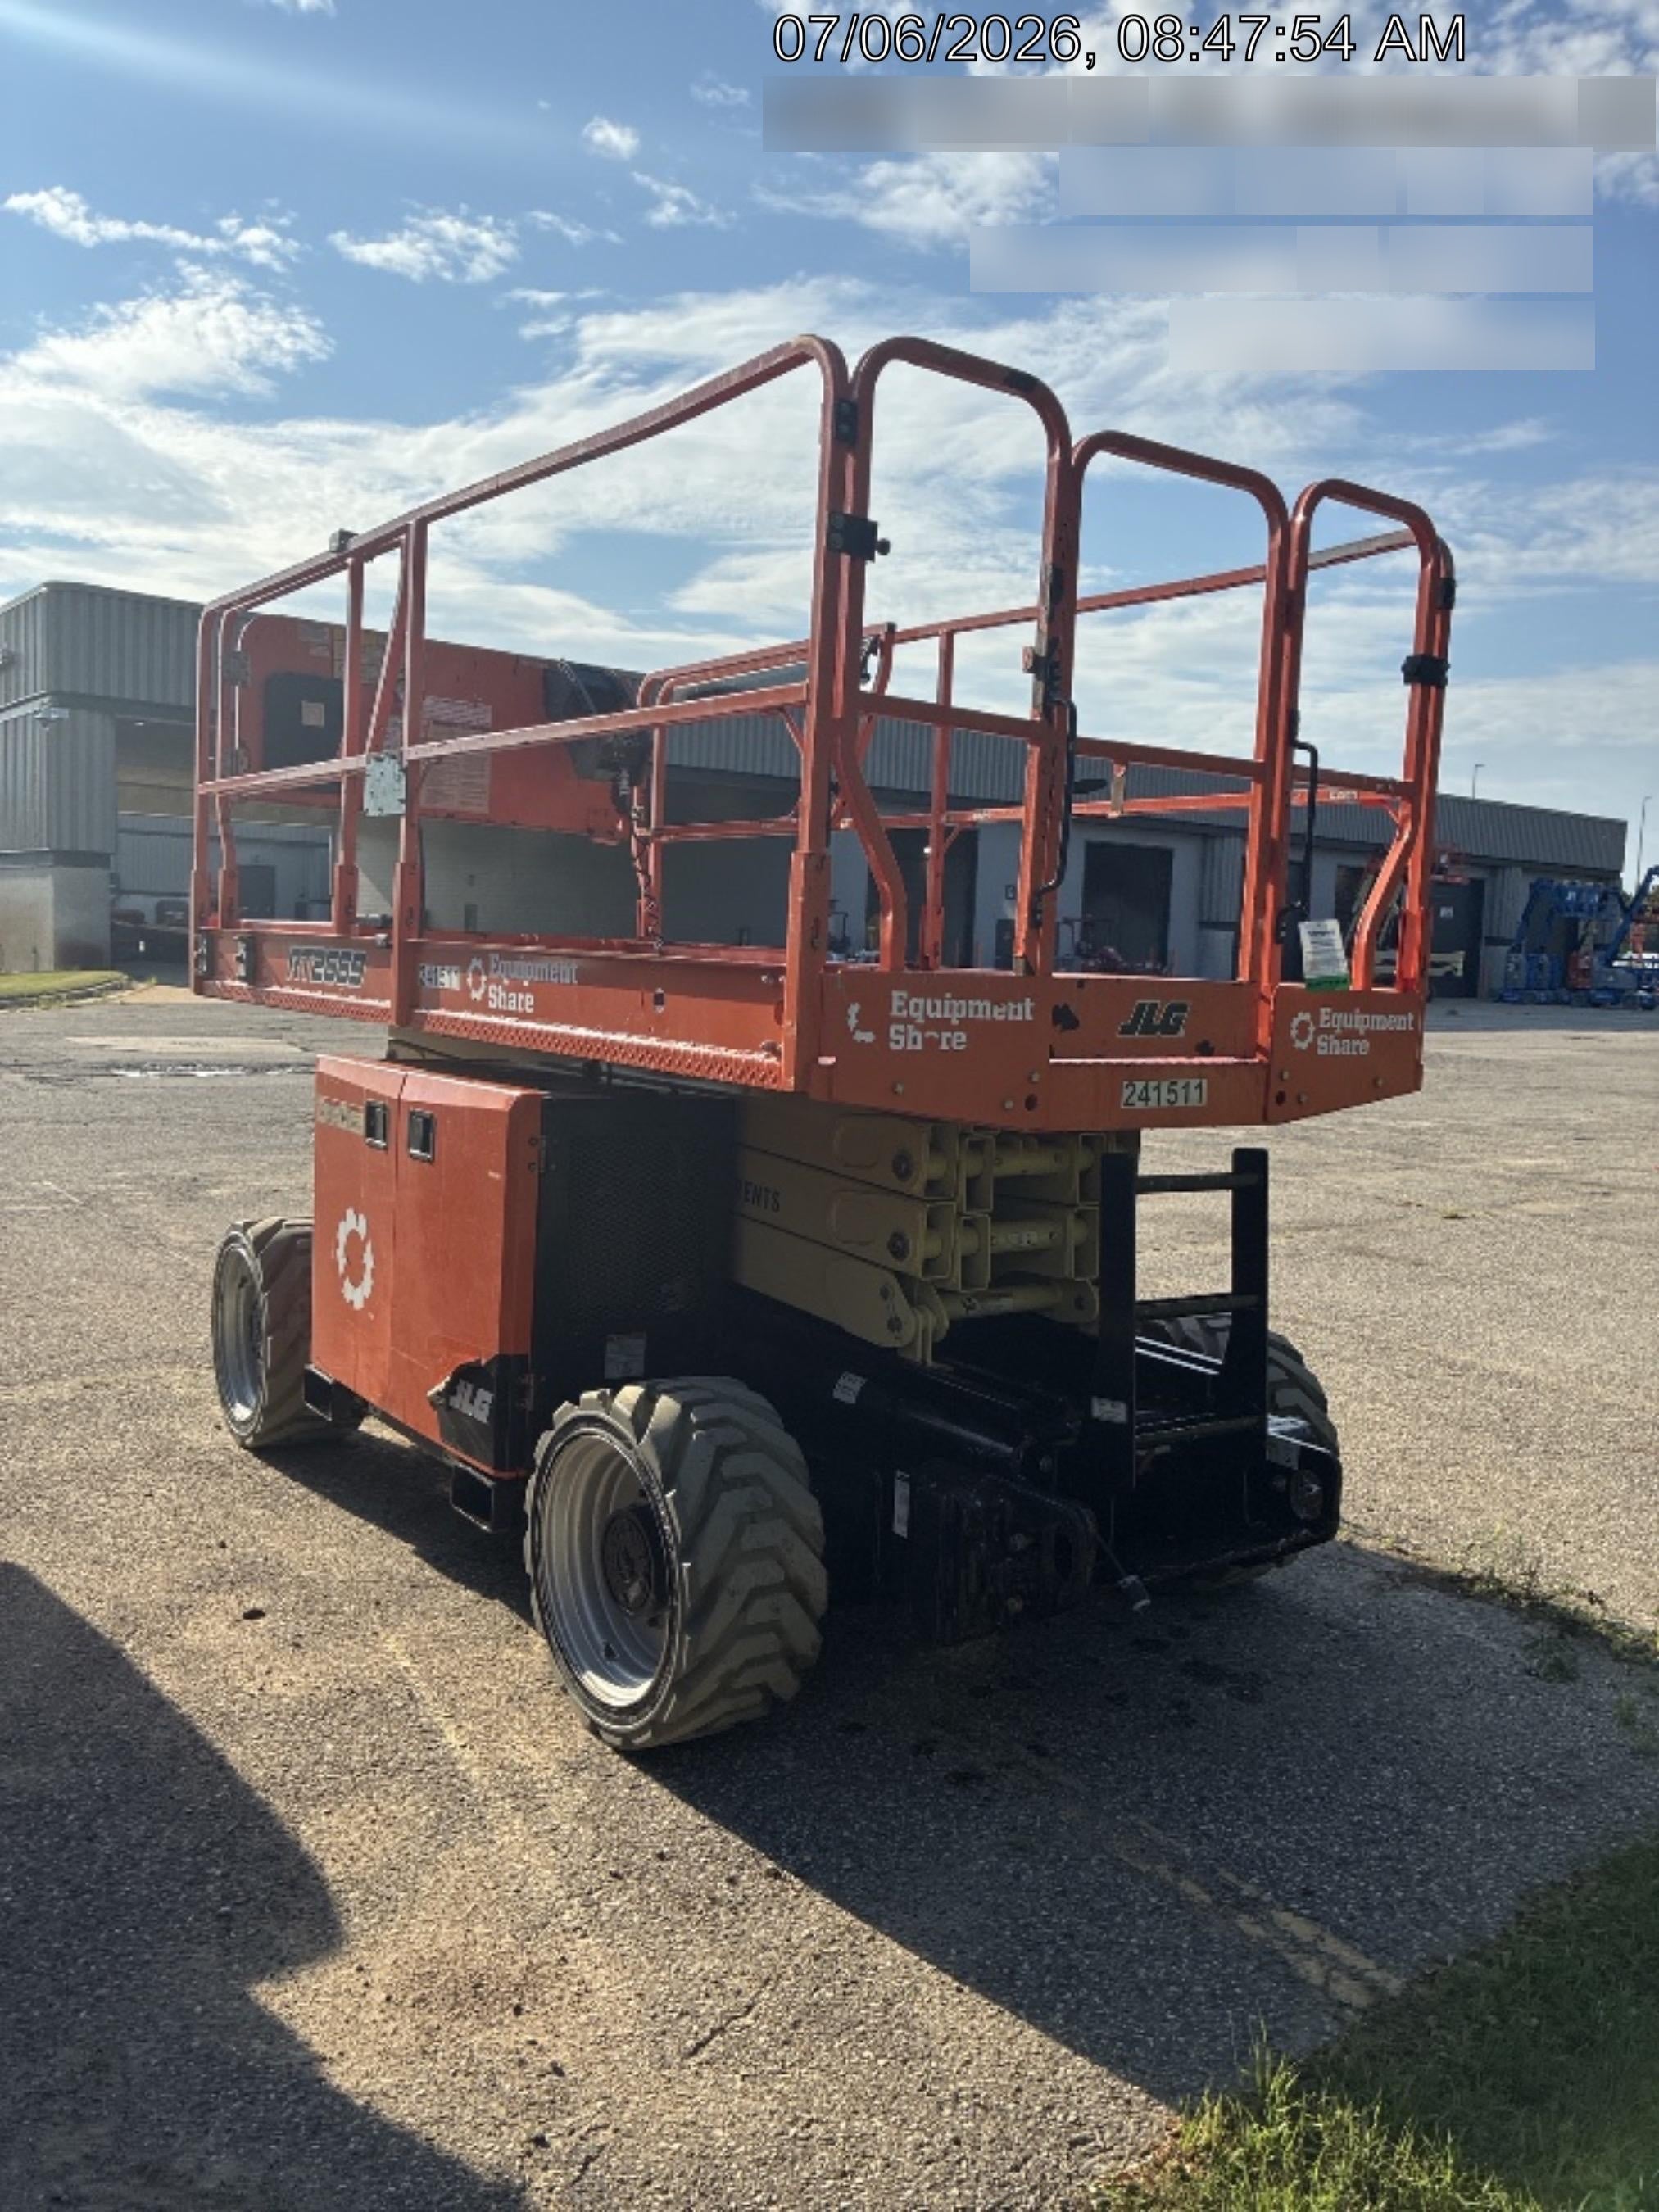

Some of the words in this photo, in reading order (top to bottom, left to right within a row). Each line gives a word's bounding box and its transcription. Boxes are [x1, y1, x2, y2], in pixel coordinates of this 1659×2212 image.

[489, 953, 578, 986] Equipment
[488, 985, 534, 1013] Share
[890, 990, 1035, 1025] Equipment
[1117, 999, 1192, 1037] JLG
[1319, 1007, 1415, 1035] Equipment
[889, 1024, 968, 1050] Shre
[1317, 1034, 1371, 1056] Share
[1122, 1079, 1204, 1108] 241511
[449, 1379, 495, 1424] JLG
